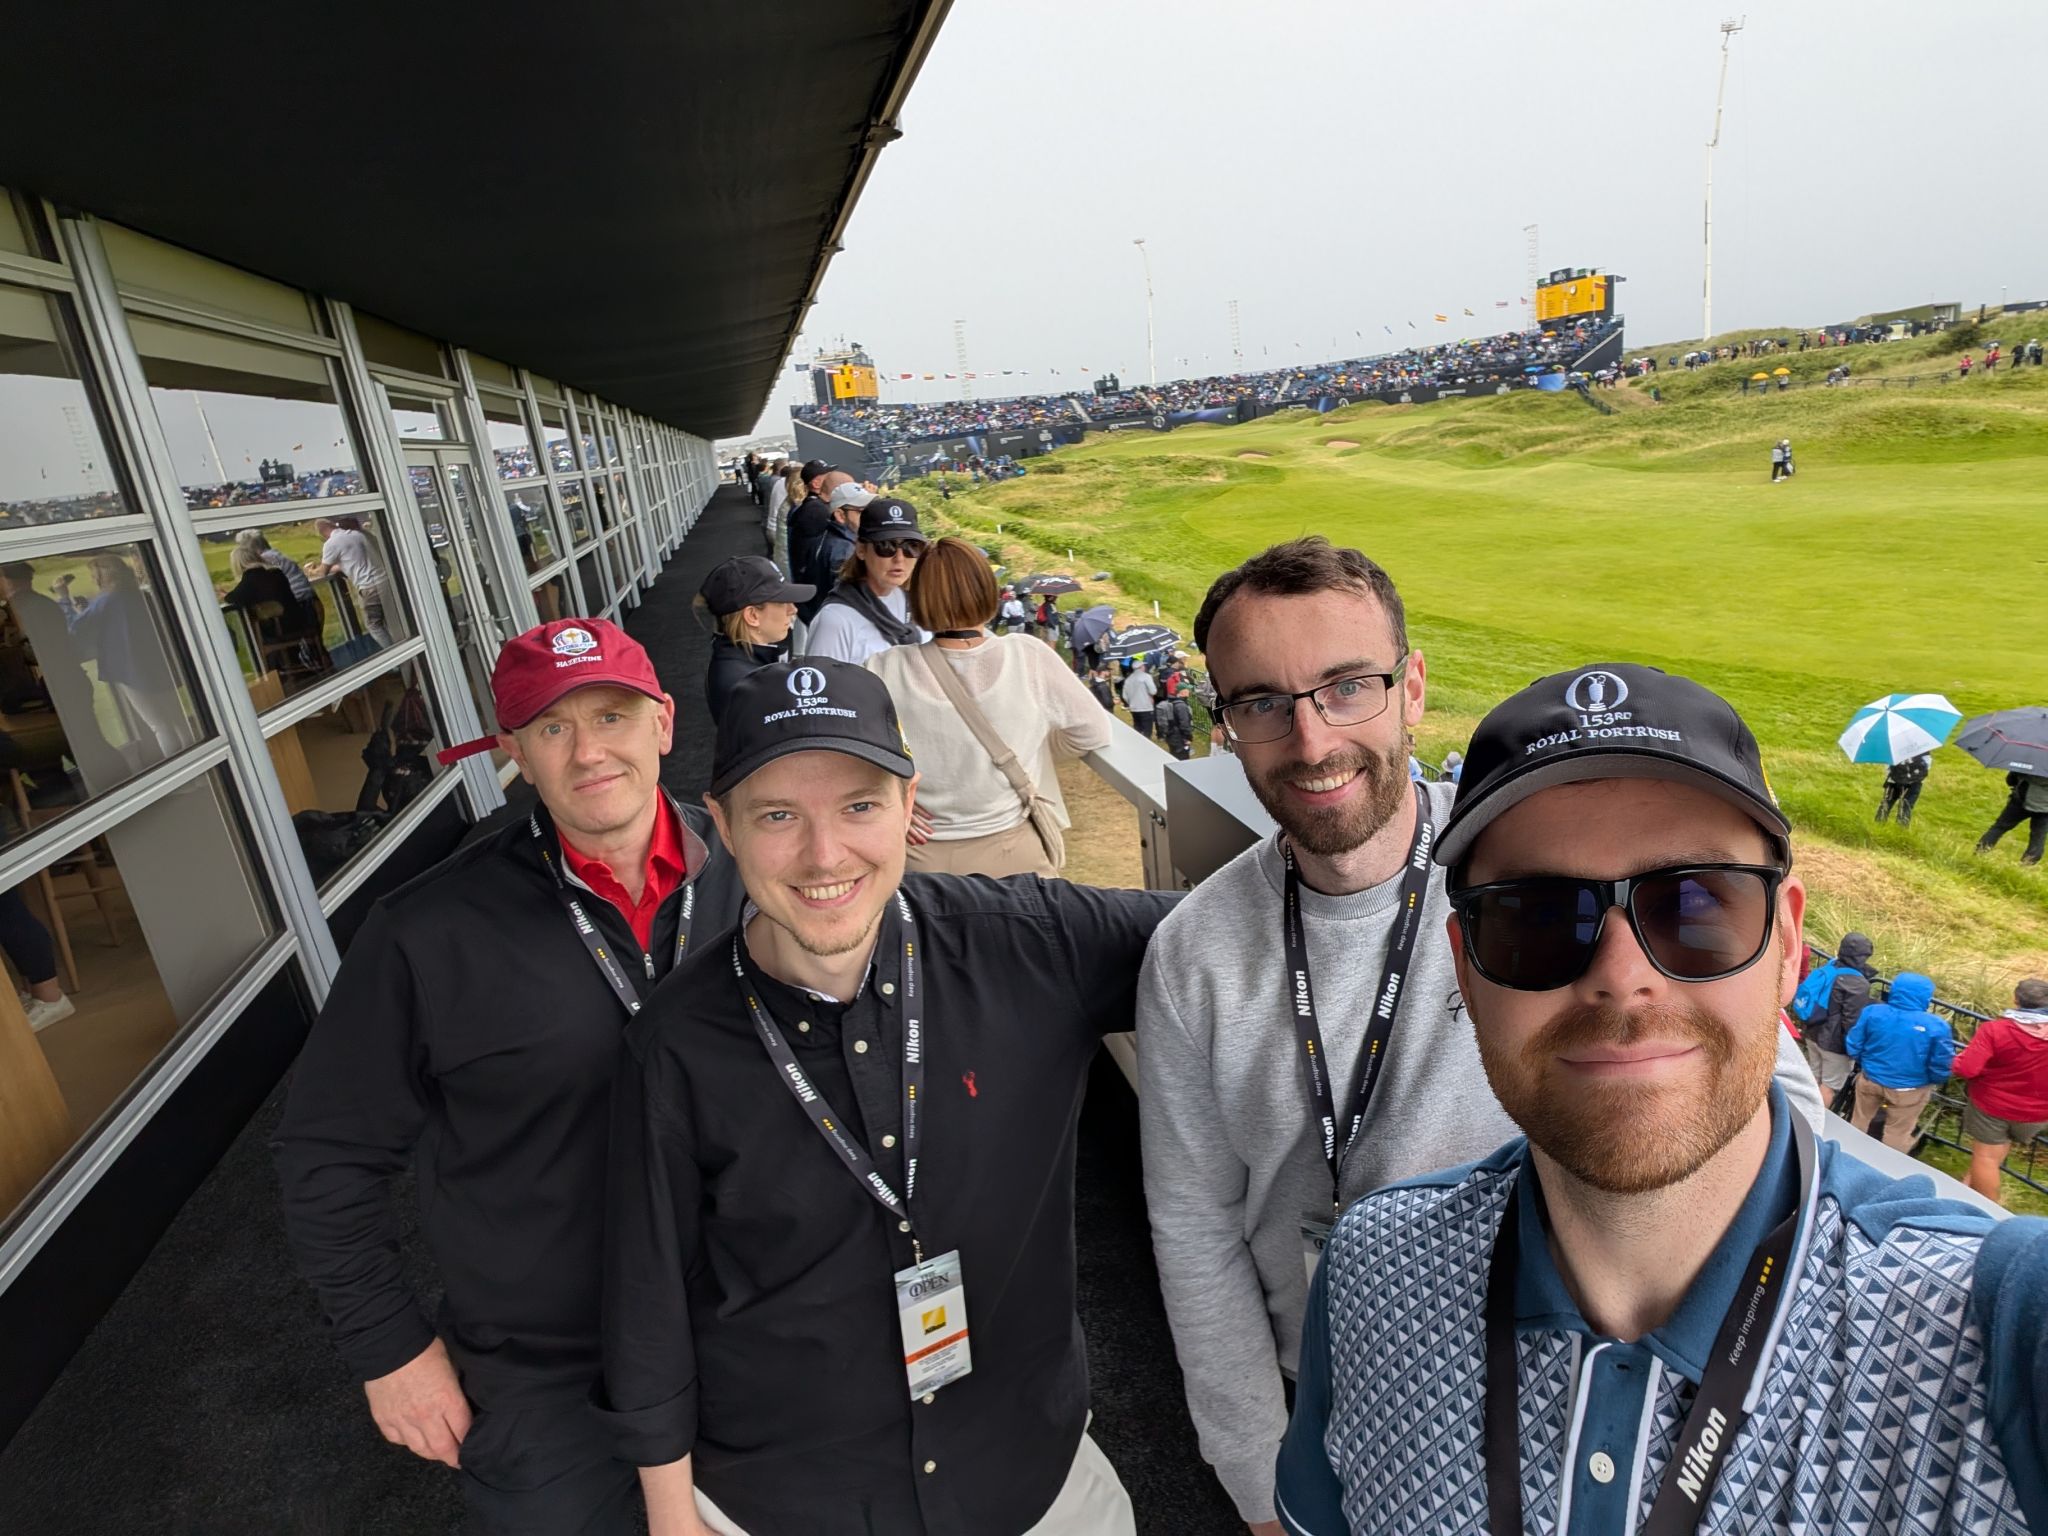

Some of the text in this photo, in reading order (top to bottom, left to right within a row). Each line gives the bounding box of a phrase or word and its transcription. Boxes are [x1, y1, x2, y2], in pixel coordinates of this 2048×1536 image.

[555, 655, 602, 668] HAZELTINE
[764, 707, 857, 724] ROYAL PORTRUSH
[796, 697, 828, 708] 153RD
[1579, 711, 1632, 728] 153RD
[1525, 726, 1682, 755] ROYAL PORTRUSH
[1413, 823, 1432, 871] Nikon
[570, 901, 594, 935] Nikon
[682, 885, 692, 920] Nikon
[1397, 908, 1413, 950] Keep inspiring
[1295, 970, 1311, 1016] Nikon
[1377, 972, 1401, 1020] Nikon
[906, 1019, 920, 1063] Nikon
[784, 1063, 818, 1102] Nikon
[1322, 1116, 1335, 1159] Nikon
[867, 1172, 899, 1206] Nikon
[909, 1272, 950, 1298] OPEN
[1728, 1284, 1766, 1367] Keep inspiring
[1676, 1407, 1728, 1504] Nikon
